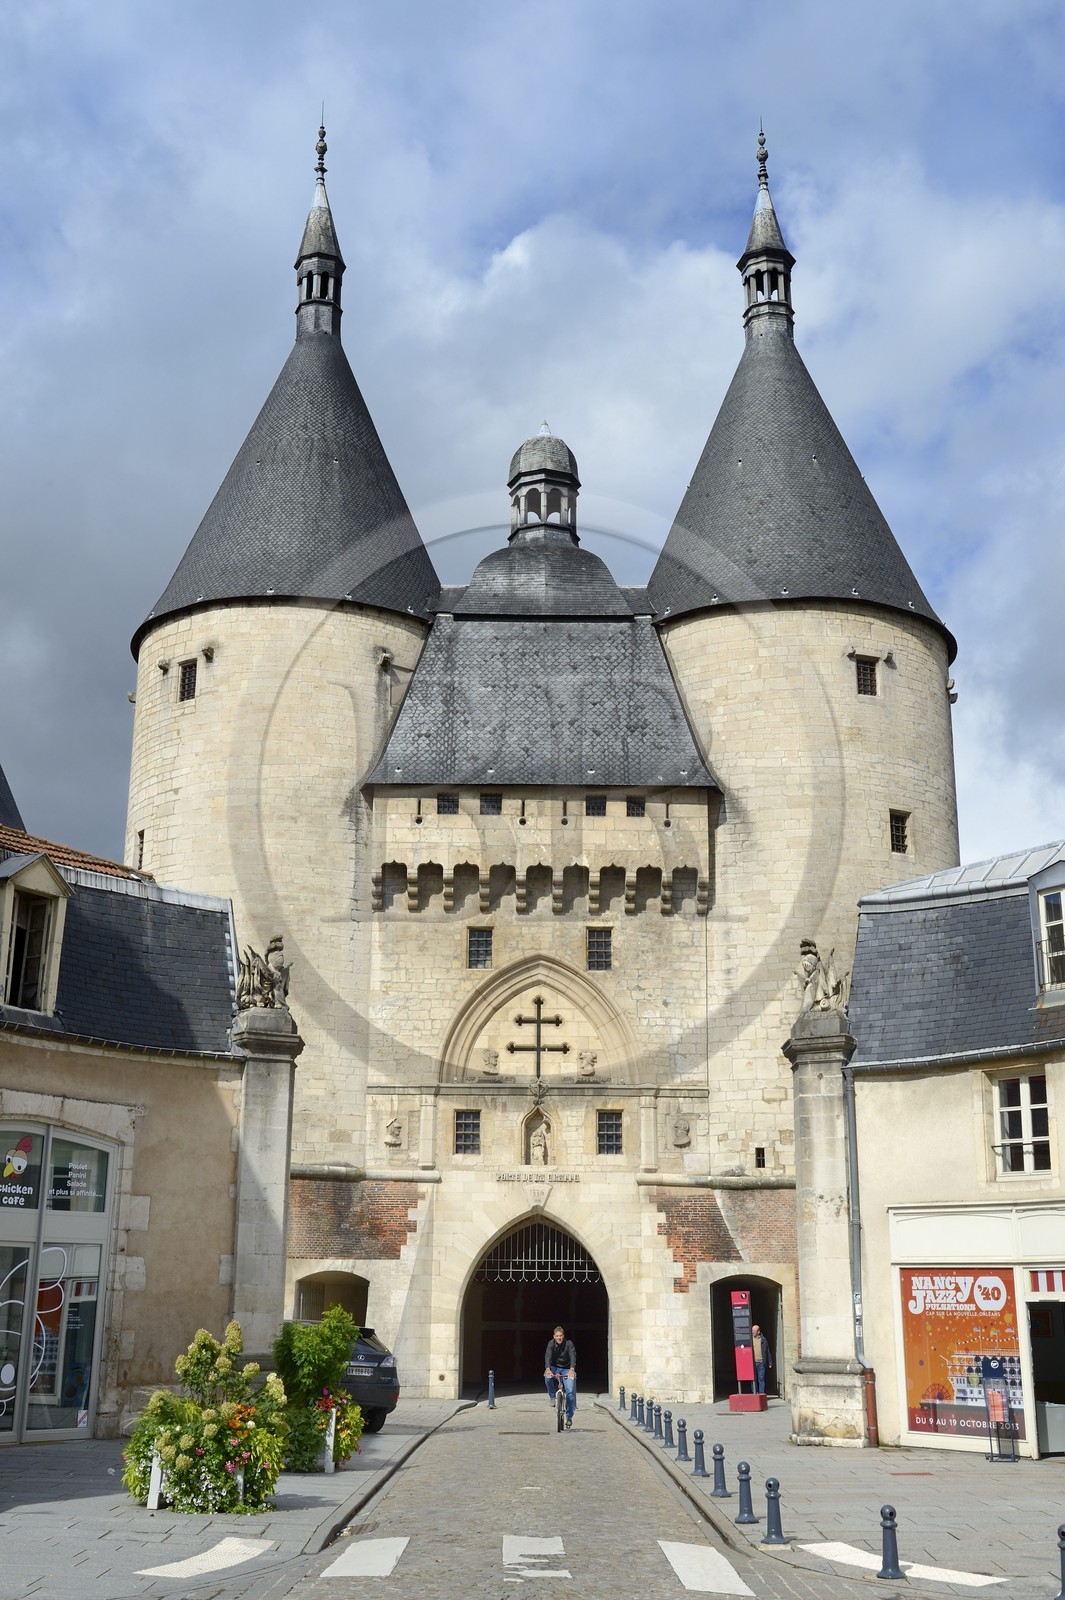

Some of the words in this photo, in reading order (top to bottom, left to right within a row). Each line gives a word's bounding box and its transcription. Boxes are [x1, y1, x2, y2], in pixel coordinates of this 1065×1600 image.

[69, 1162, 87, 1170] Poulet
[908, 1290, 957, 1314] JAZZ
[925, 1303, 976, 1311] PULSATIONS
[936, 1418, 946, 1426] AU
[960, 1420, 997, 1429] OCTOBRE
